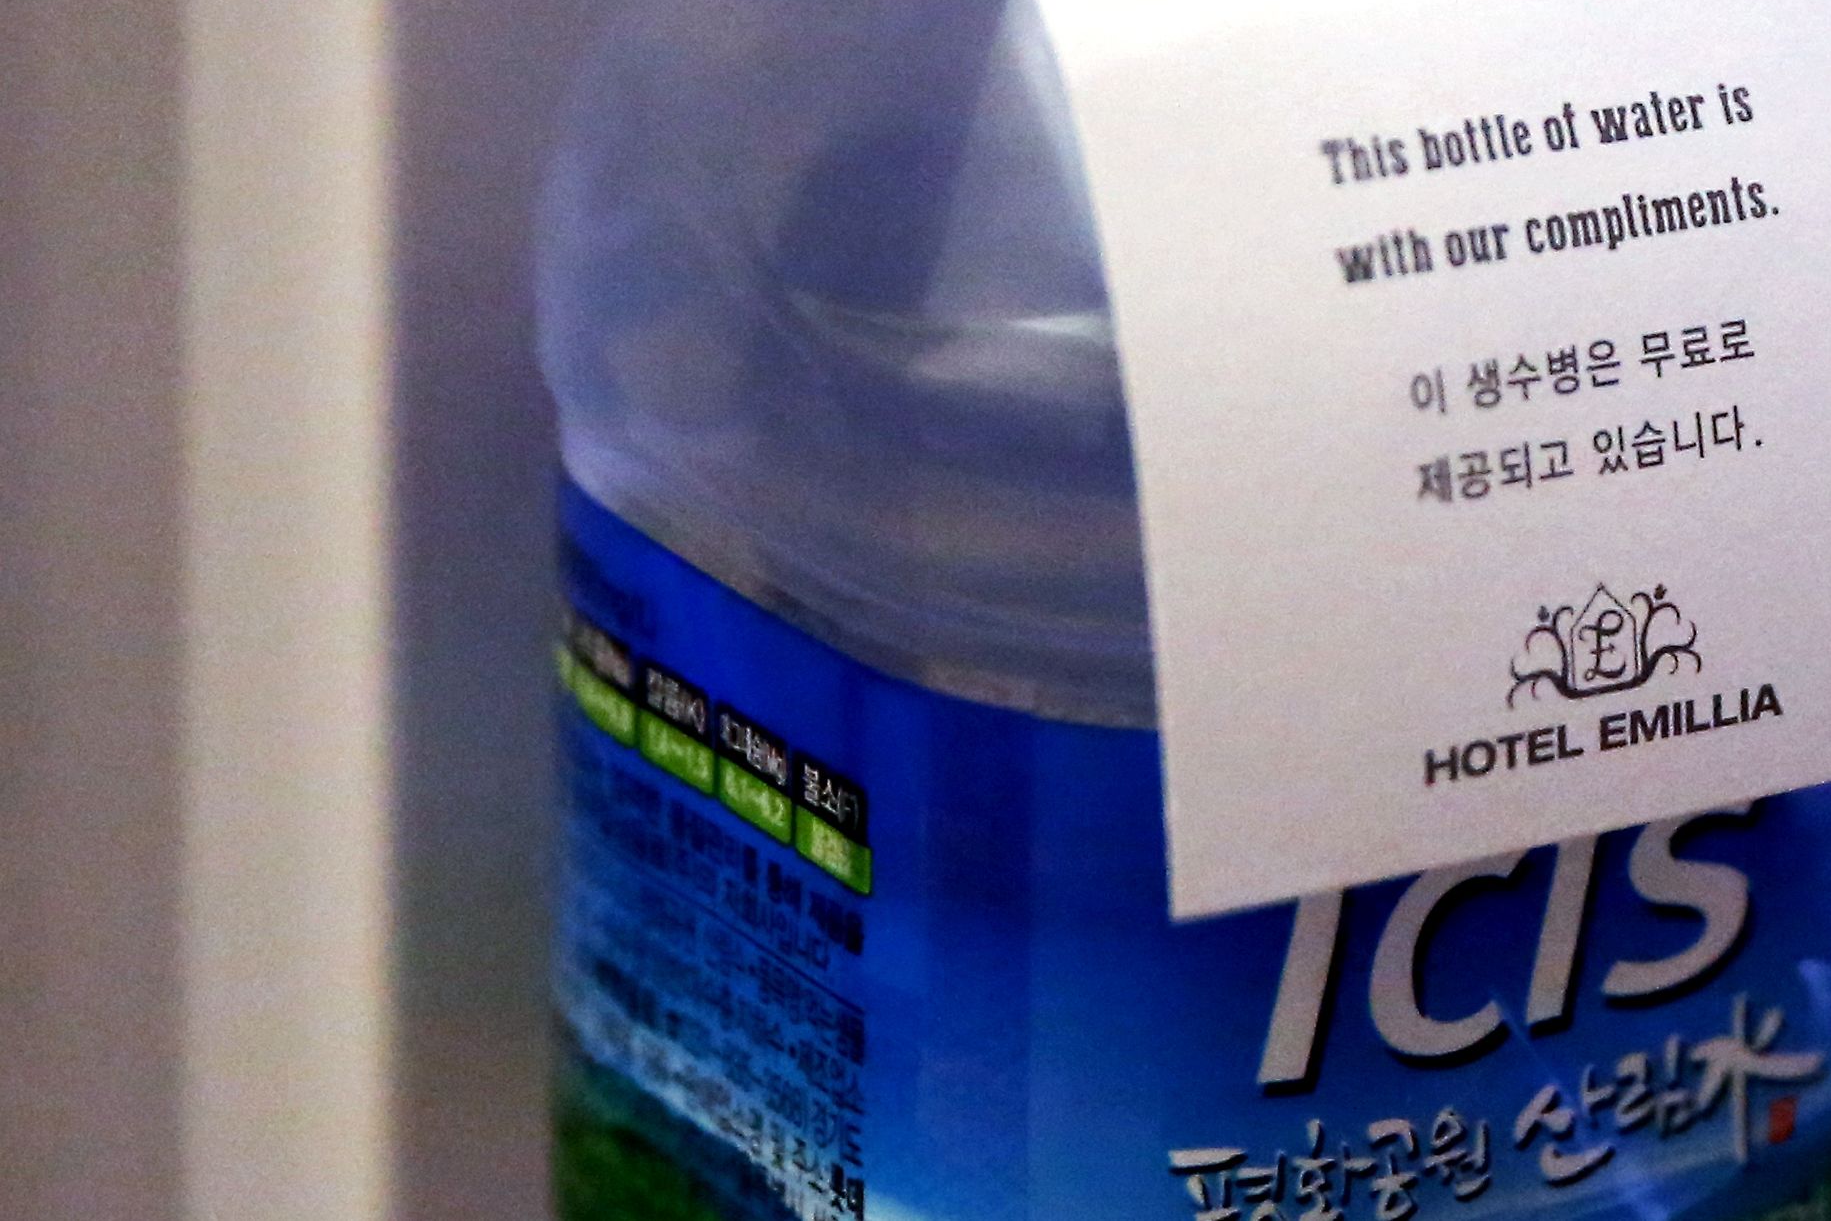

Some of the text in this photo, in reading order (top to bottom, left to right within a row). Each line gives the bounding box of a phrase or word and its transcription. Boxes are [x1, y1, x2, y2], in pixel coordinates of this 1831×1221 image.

[1319, 83, 1753, 184] This bottle of water is
[1335, 177, 1779, 284] with our compliments.
[1410, 319, 1755, 413] 이 생수병은 무료로
[1417, 405, 1762, 502] 제공되고 있습니다.
[1424, 684, 1783, 786] HOTEL EMILLIA
